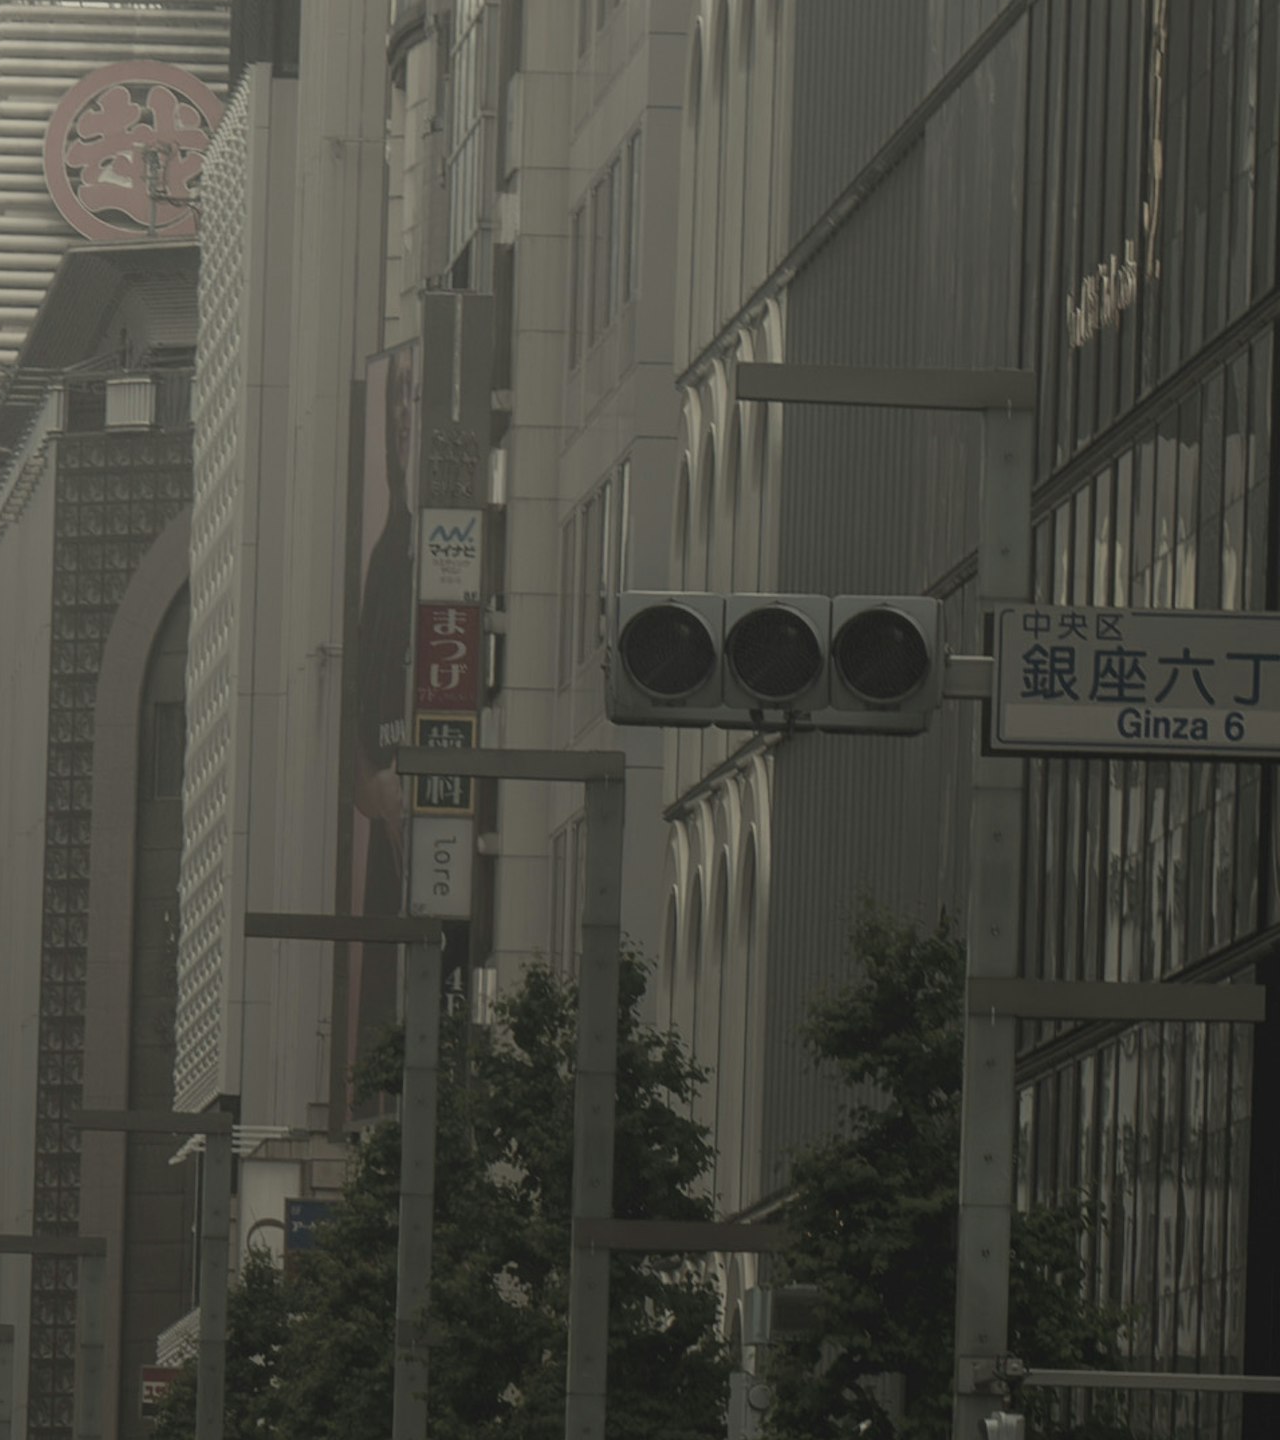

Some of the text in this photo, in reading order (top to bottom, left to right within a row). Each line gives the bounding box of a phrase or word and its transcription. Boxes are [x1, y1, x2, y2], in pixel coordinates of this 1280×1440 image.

[1022, 609, 1125, 641] 中央区
[429, 607, 468, 691] まつげ
[1117, 708, 1245, 742] Ginza 6
